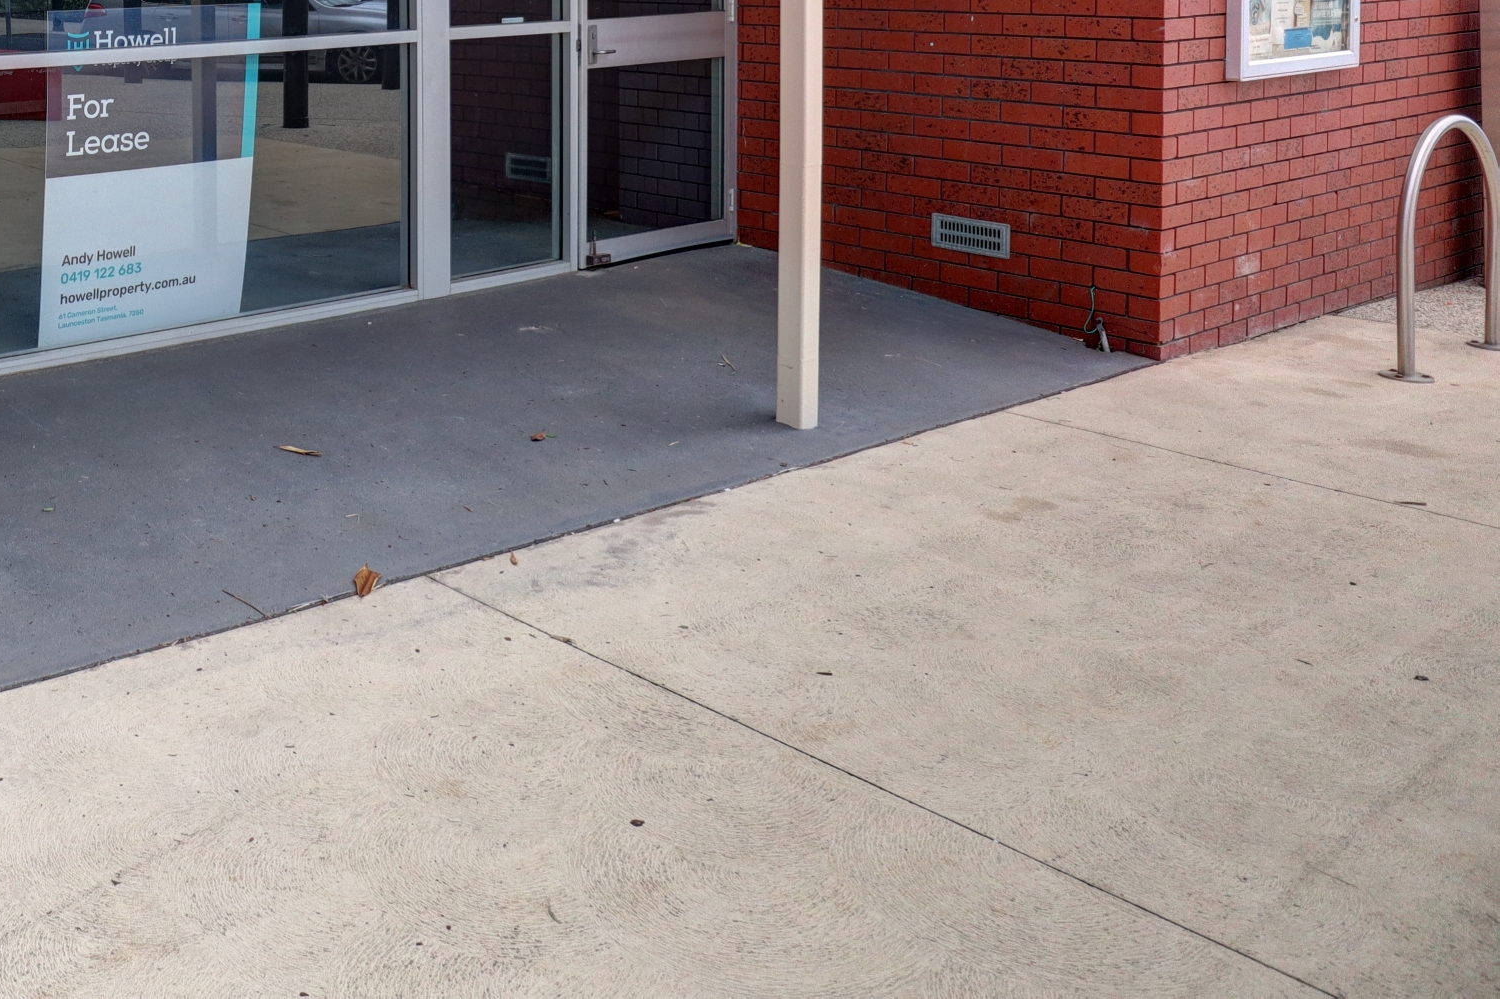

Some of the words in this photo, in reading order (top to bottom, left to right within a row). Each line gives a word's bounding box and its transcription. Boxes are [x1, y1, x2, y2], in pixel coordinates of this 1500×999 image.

[93, 27, 177, 48] Howell
[66, 93, 115, 121] For
[65, 131, 150, 157] Lease
[61, 252, 94, 267] Andy
[96, 245, 136, 262] Howell
[60, 269, 91, 285] 0419
[94, 265, 115, 280] 122
[118, 261, 142, 276] 683
[60, 275, 196, 305] howellproperty.com.au
[57, 316, 96, 330] Launceston
[128, 308, 145, 318] 7250
[58, 312, 66, 320] 61
[67, 308, 96, 319] Cameron
